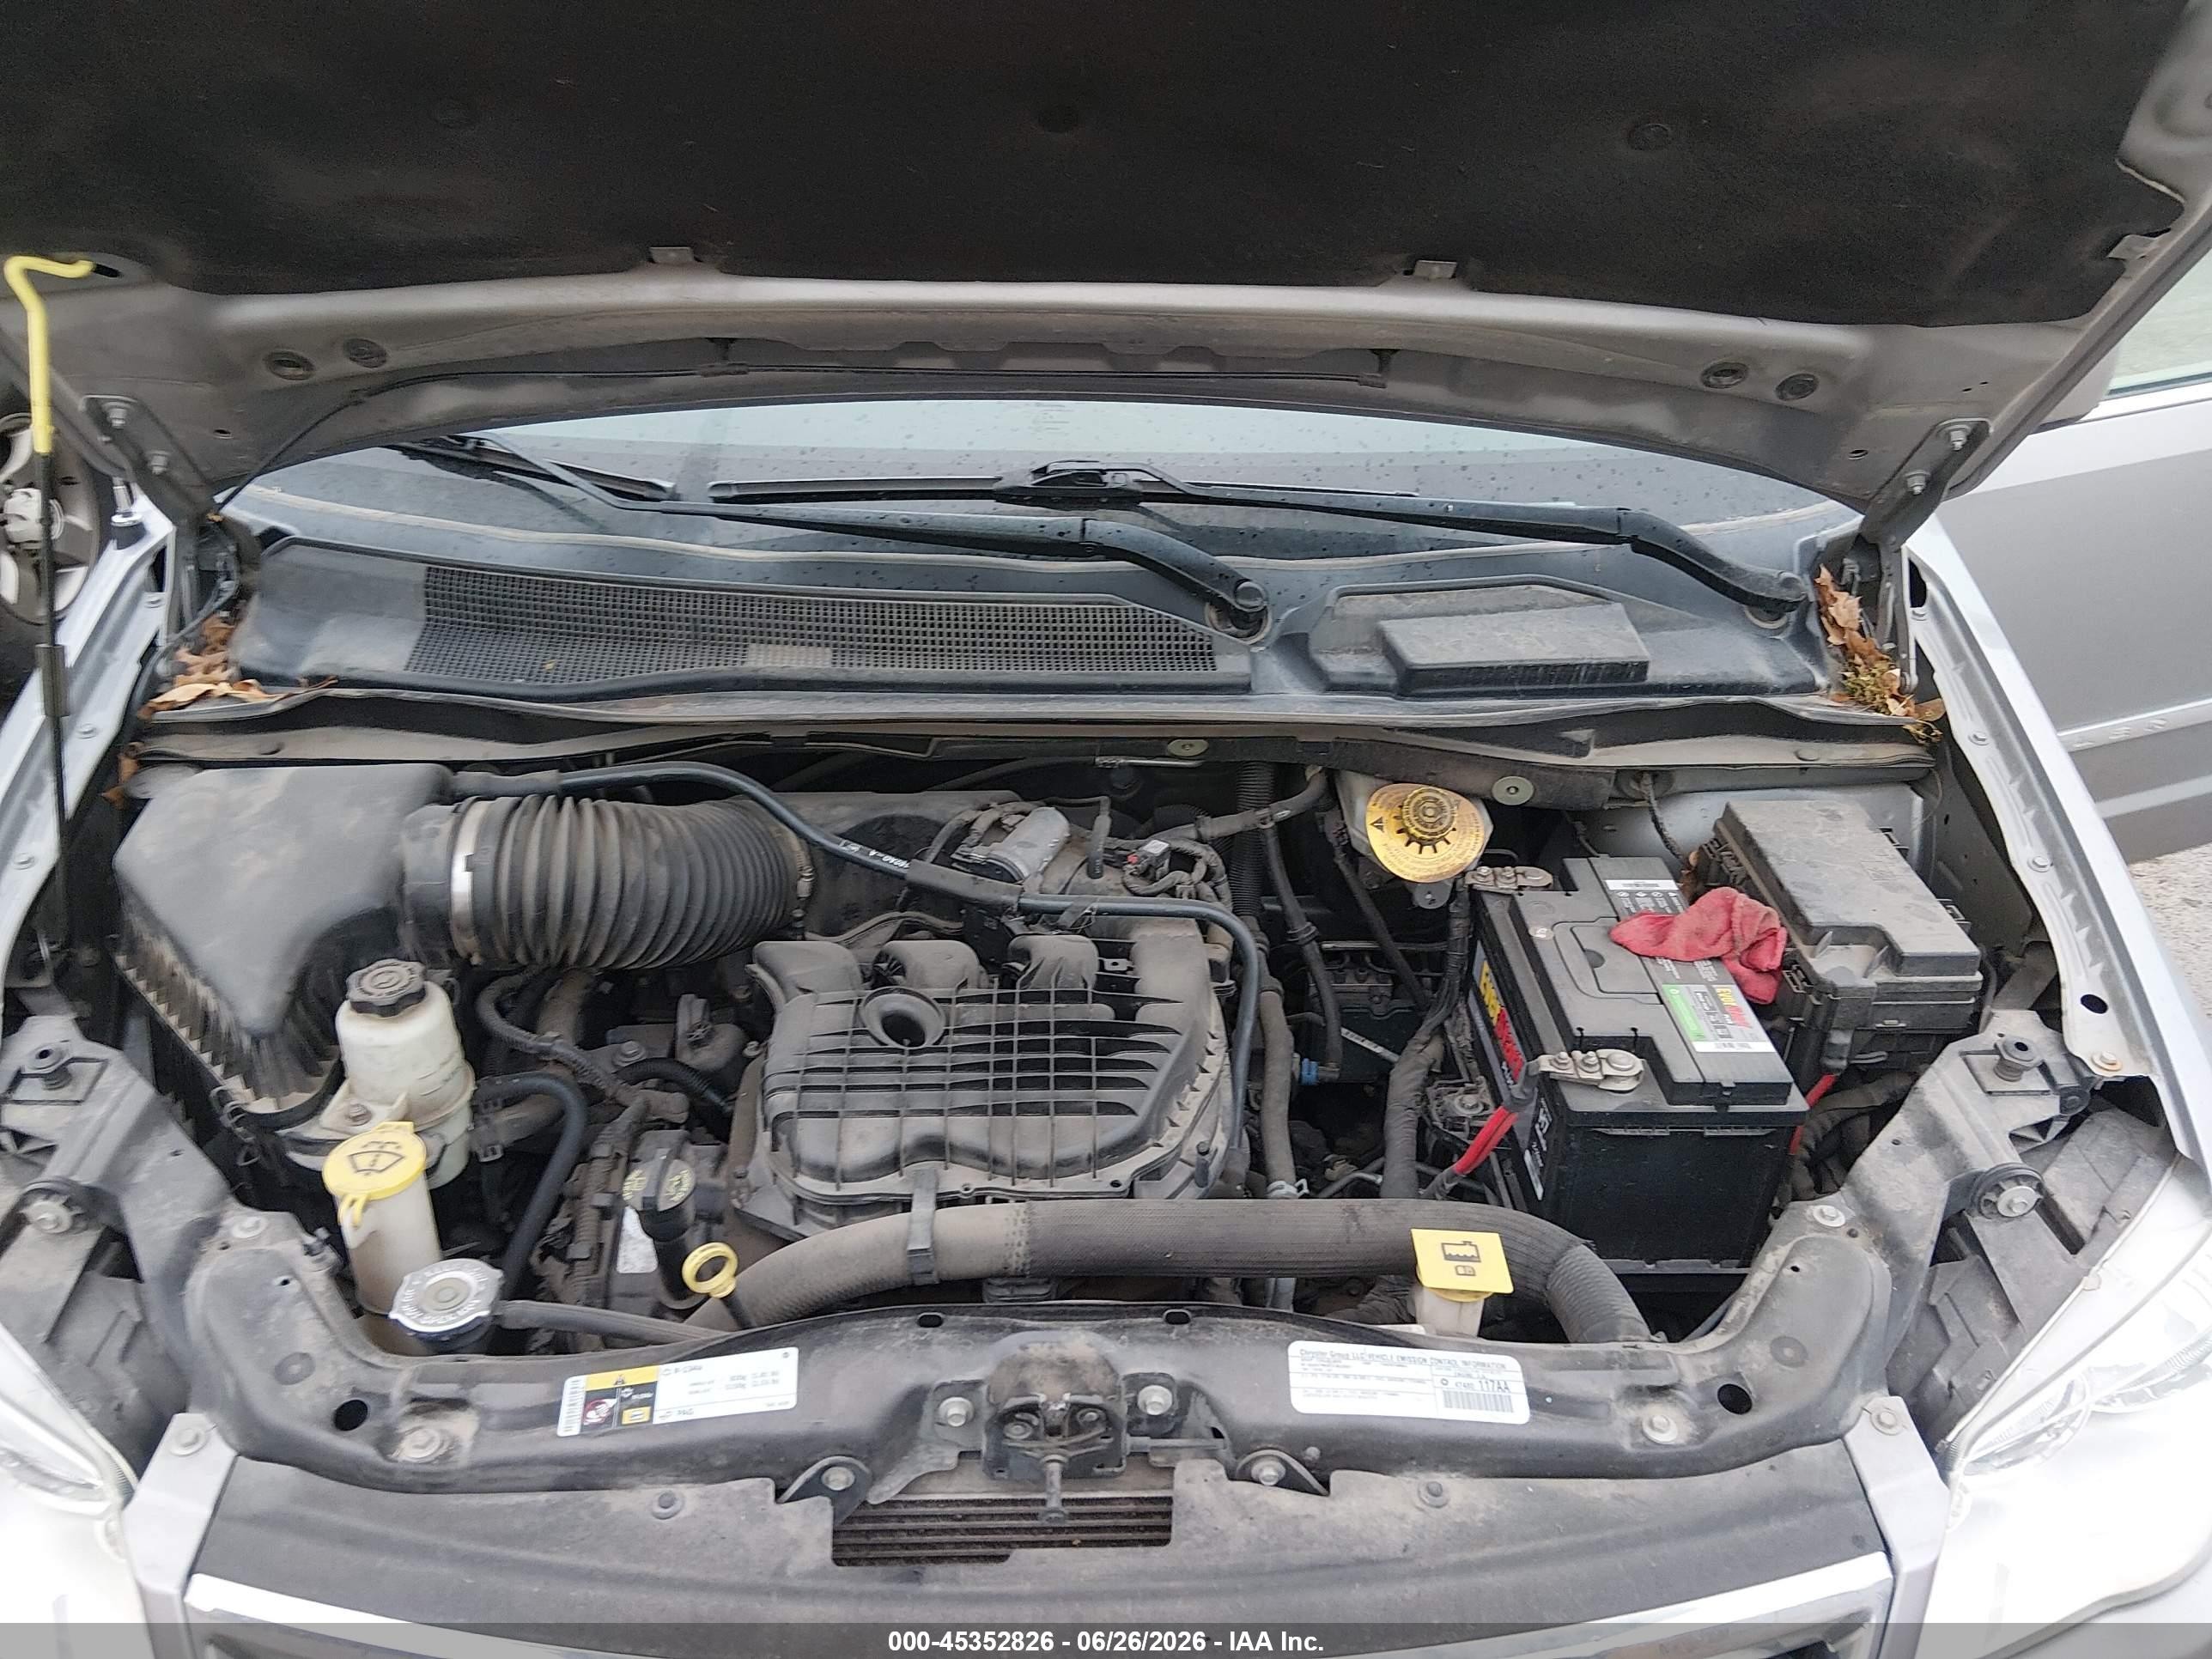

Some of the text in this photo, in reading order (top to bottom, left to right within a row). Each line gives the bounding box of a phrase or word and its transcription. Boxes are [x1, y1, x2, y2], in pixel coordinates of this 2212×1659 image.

[1396, 1353, 1427, 1364] EMISSION
[1430, 1356, 1458, 1367] CONTROL
[1462, 1359, 1507, 1370] INFORMATION
